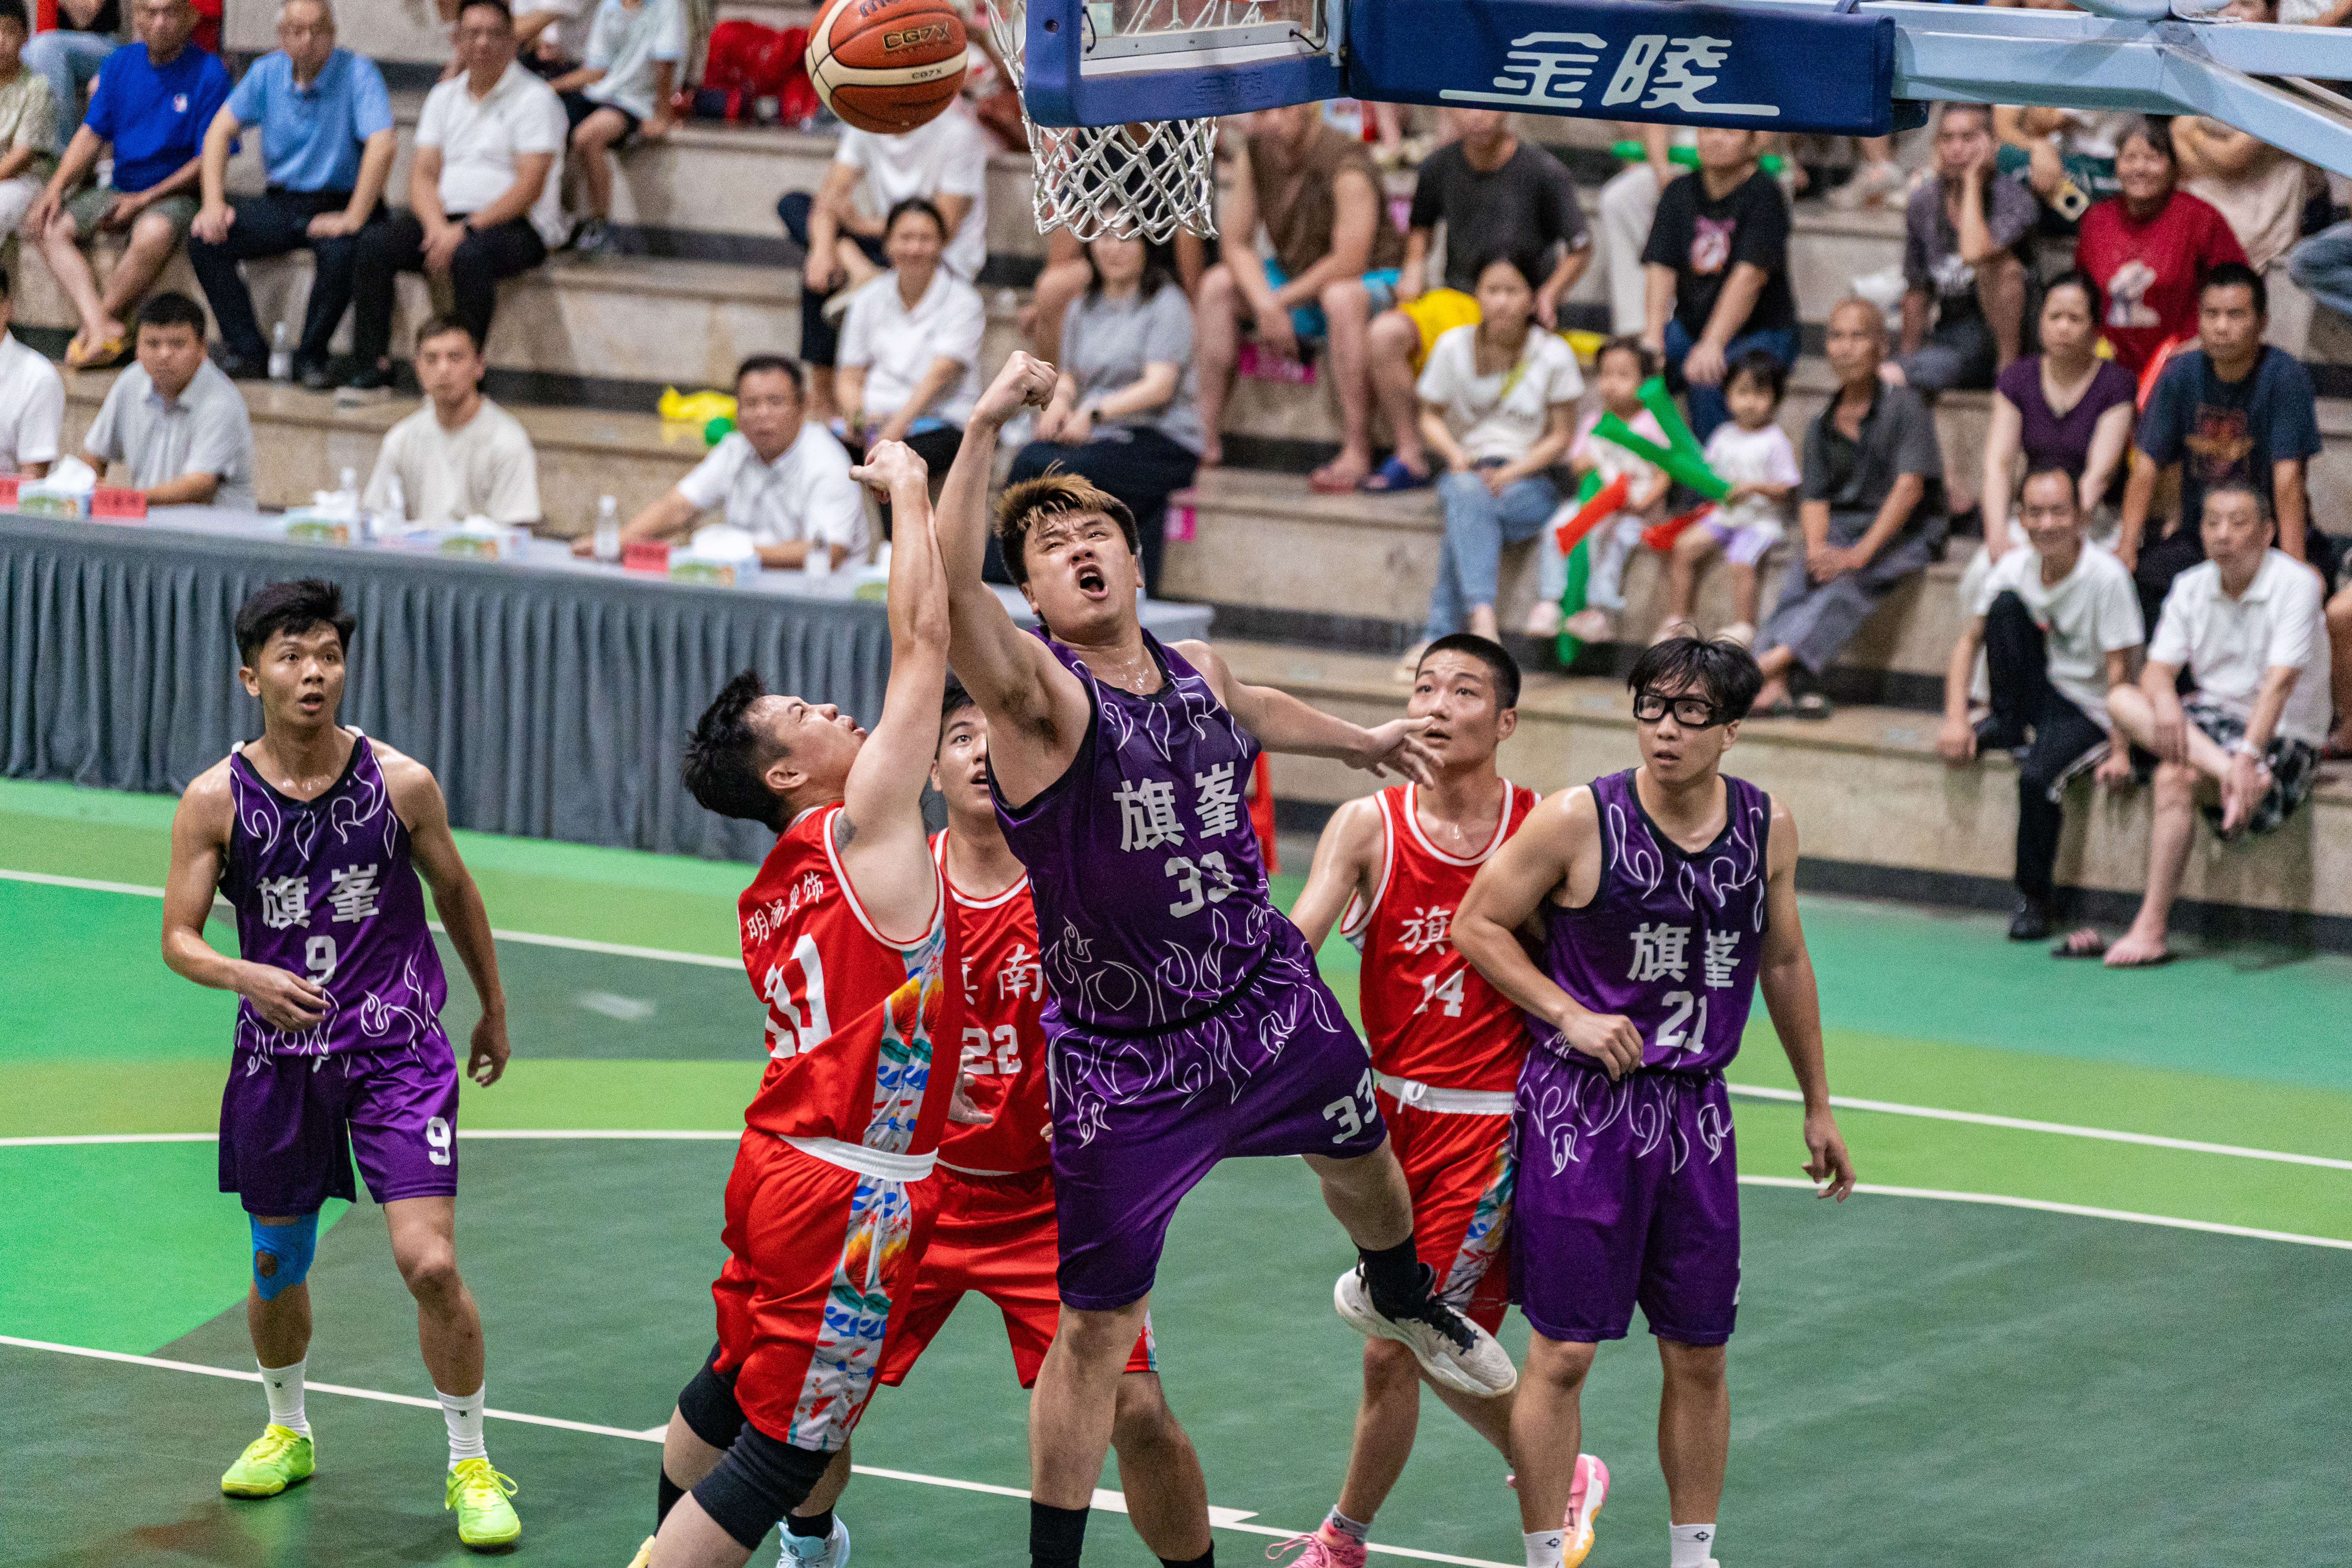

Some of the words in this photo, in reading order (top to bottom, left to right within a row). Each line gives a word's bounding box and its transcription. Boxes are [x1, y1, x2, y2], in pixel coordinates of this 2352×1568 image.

[1439, 31, 1780, 116] 金陵
[1164, 850, 1239, 918] 33
[305, 935, 337, 986] 9
[1413, 968, 1465, 1017] 14
[960, 1024, 1023, 1075] 22
[1655, 991, 1708, 1054] 21
[1322, 1067, 1377, 1144] 33
[426, 1116, 452, 1166] 9
